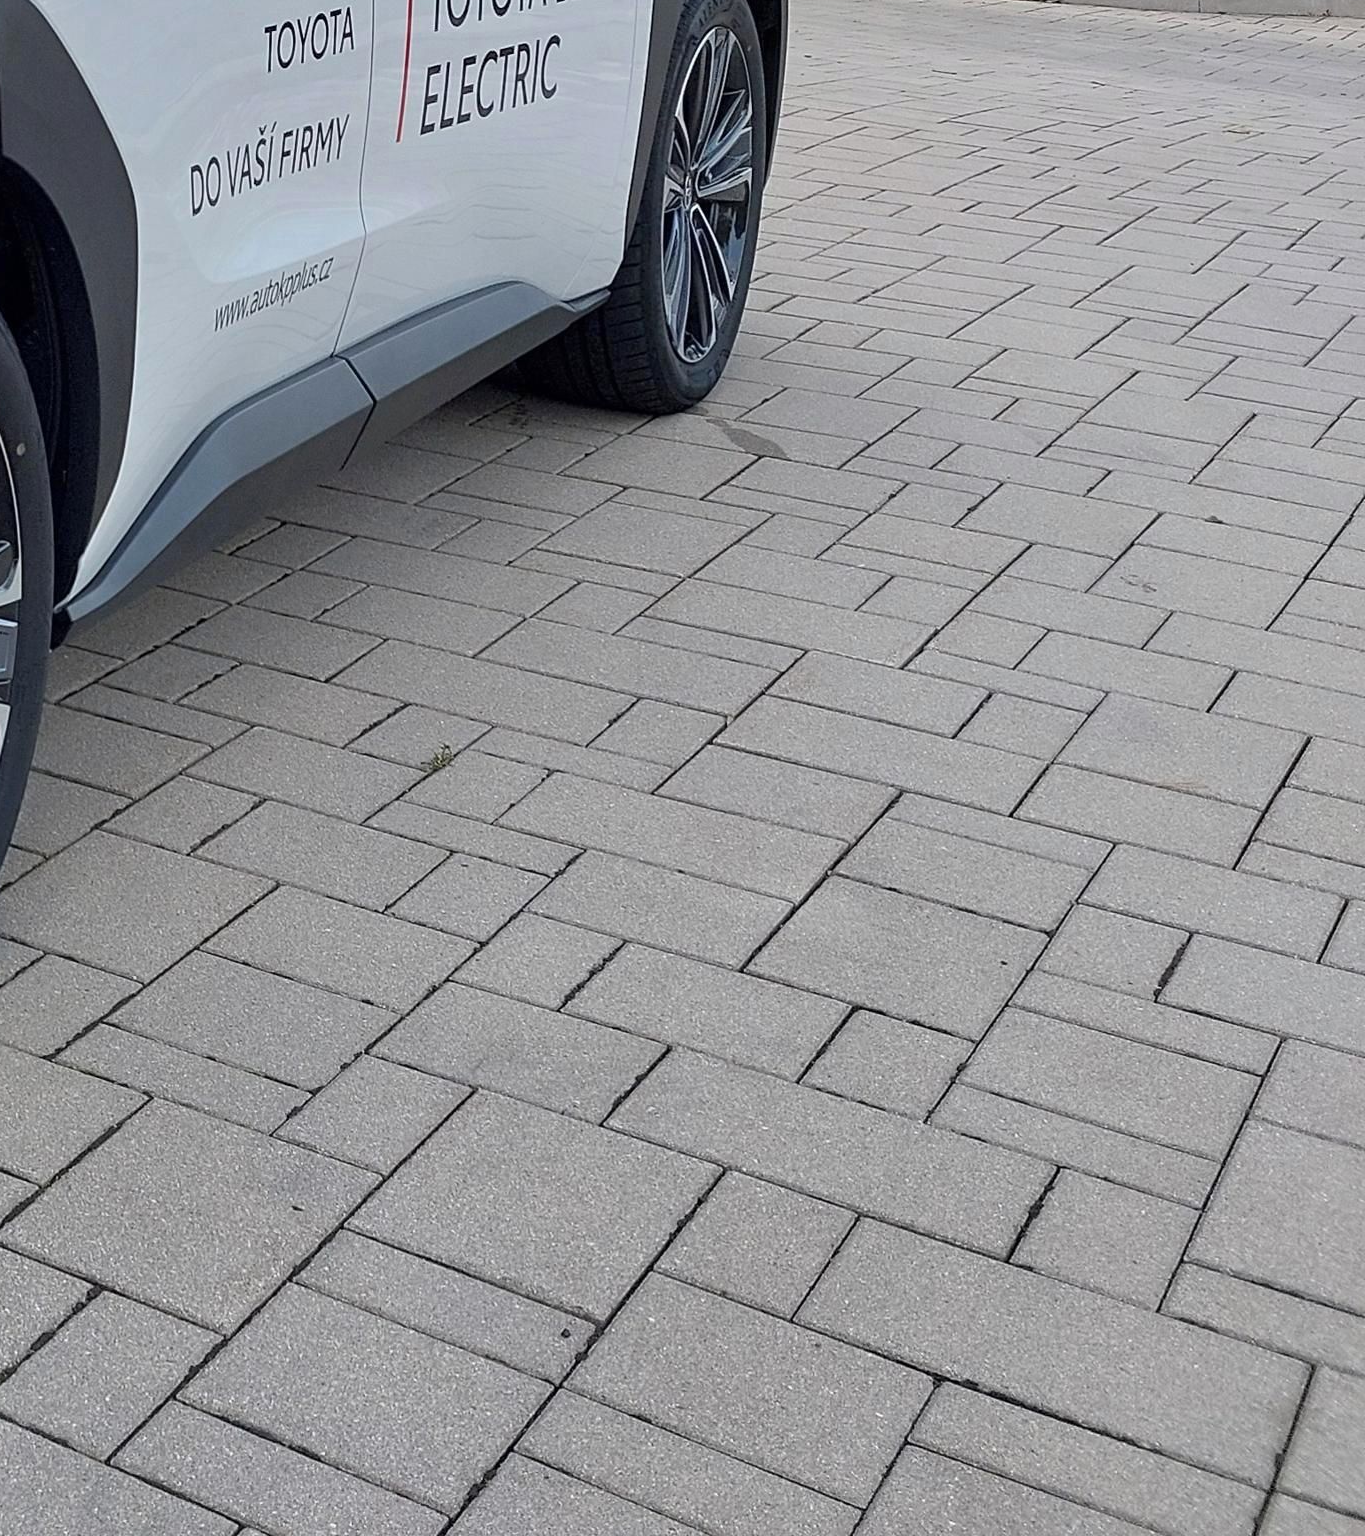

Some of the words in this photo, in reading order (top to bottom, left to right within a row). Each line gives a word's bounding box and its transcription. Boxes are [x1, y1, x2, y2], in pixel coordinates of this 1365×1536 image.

[264, 7, 355, 73] TOYOTA
[420, 35, 562, 135] ELECTRIC
[190, 156, 222, 217] DO
[226, 121, 277, 197] VAŠÍ
[278, 114, 350, 179] FIRMY
[214, 256, 334, 332] www.autokpplus.cz
